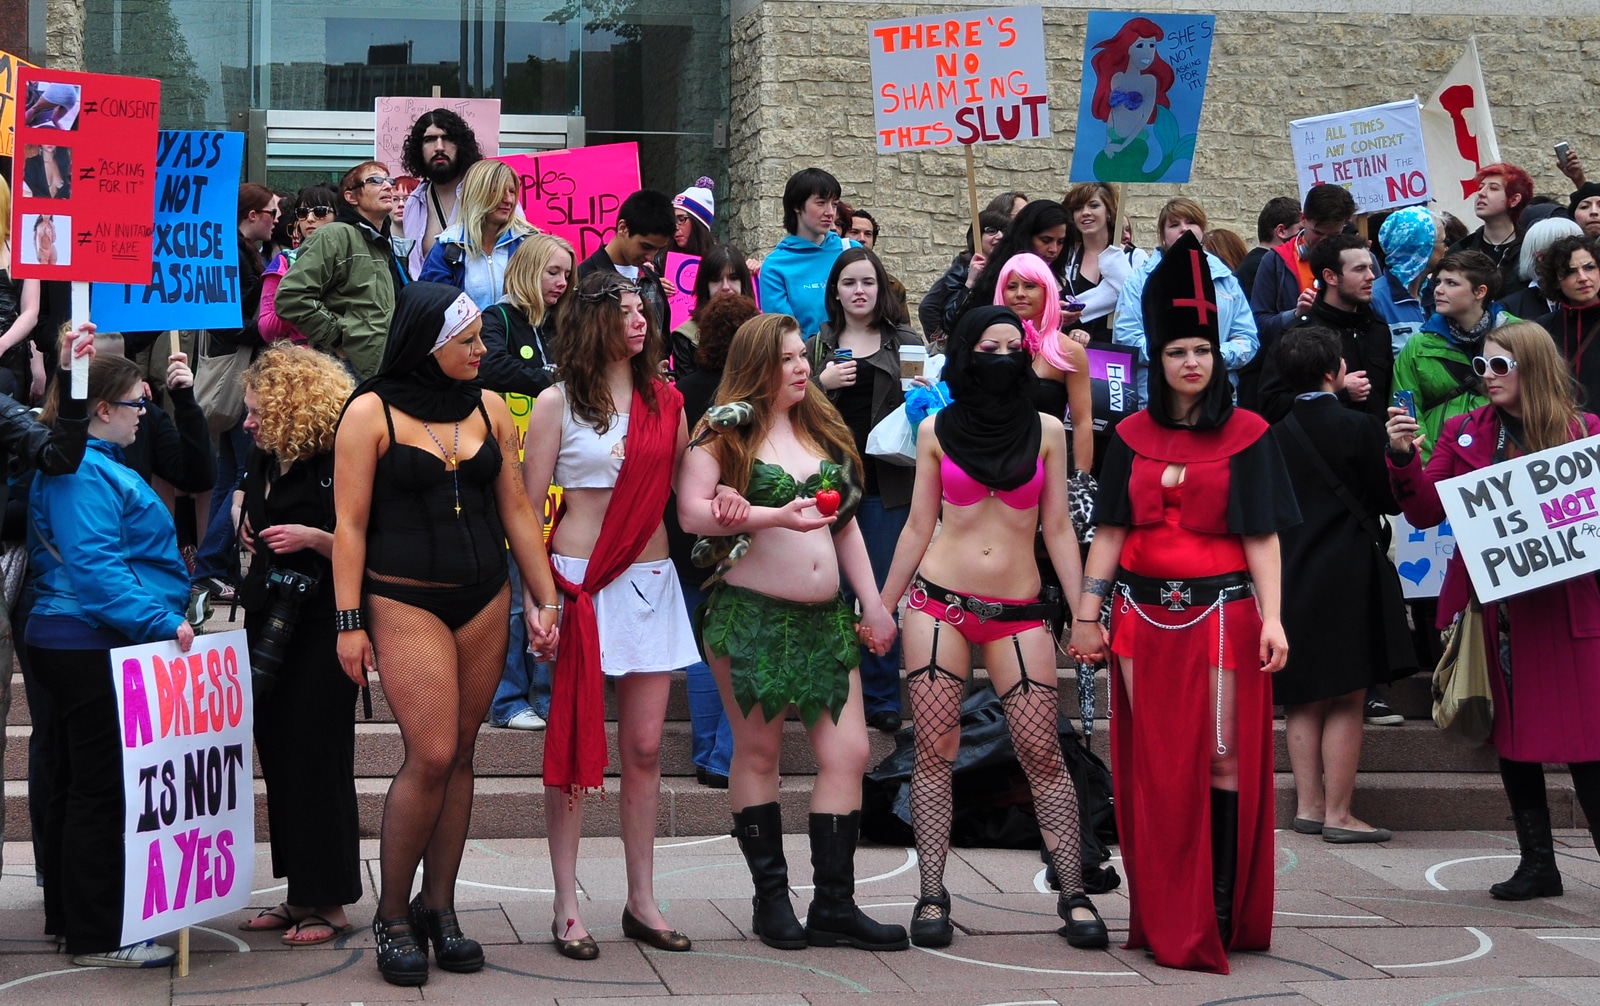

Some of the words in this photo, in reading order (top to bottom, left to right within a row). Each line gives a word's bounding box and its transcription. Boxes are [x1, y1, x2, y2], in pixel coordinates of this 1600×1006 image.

[873, 16, 1017, 53] THERE'S
[1167, 20, 1212, 50] SHE'S
[935, 52, 980, 78] NO
[1169, 45, 1194, 66] NOT
[1176, 58, 1201, 75] ASKING
[880, 70, 1029, 113] SHAMING
[1180, 69, 1199, 83] FOR
[1188, 78, 1202, 91] IT!
[100, 97, 158, 120] CONSENT
[879, 121, 954, 148] THIS
[955, 95, 1047, 145] SLUT
[1308, 153, 1320, 161] in
[1325, 143, 1345, 158] ANY
[1350, 133, 1404, 155] CONTEXT
[1325, 125, 1347, 141] ALL
[1350, 118, 1385, 136] TIMES
[99, 178, 121, 193] FOR
[1308, 163, 1326, 186] I
[1332, 153, 1388, 182] RETAIN
[1394, 157, 1414, 168] THE
[159, 174, 209, 215] NOT
[1356, 192, 1367, 204] to
[1369, 194, 1385, 208] say
[1385, 170, 1427, 203] NO
[546, 193, 620, 225] SLIP
[94, 222, 111, 238] AN
[94, 240, 105, 254] TO
[111, 239, 140, 254] RAPE
[153, 220, 223, 260] XCUSE
[142, 261, 238, 305] ASSAULT
[1107, 364, 1123, 410] HOW
[1457, 470, 1514, 519] MY
[1525, 444, 1600, 495] BODY
[1492, 509, 1528, 539] IS
[1539, 486, 1597, 525] NOT
[1480, 525, 1586, 588] PUBLIC
[122, 657, 153, 748] A
[151, 645, 244, 739] DRESS
[136, 758, 178, 834] IS
[183, 742, 245, 821] NOT
[141, 838, 169, 921] A
[172, 826, 236, 912] YES
